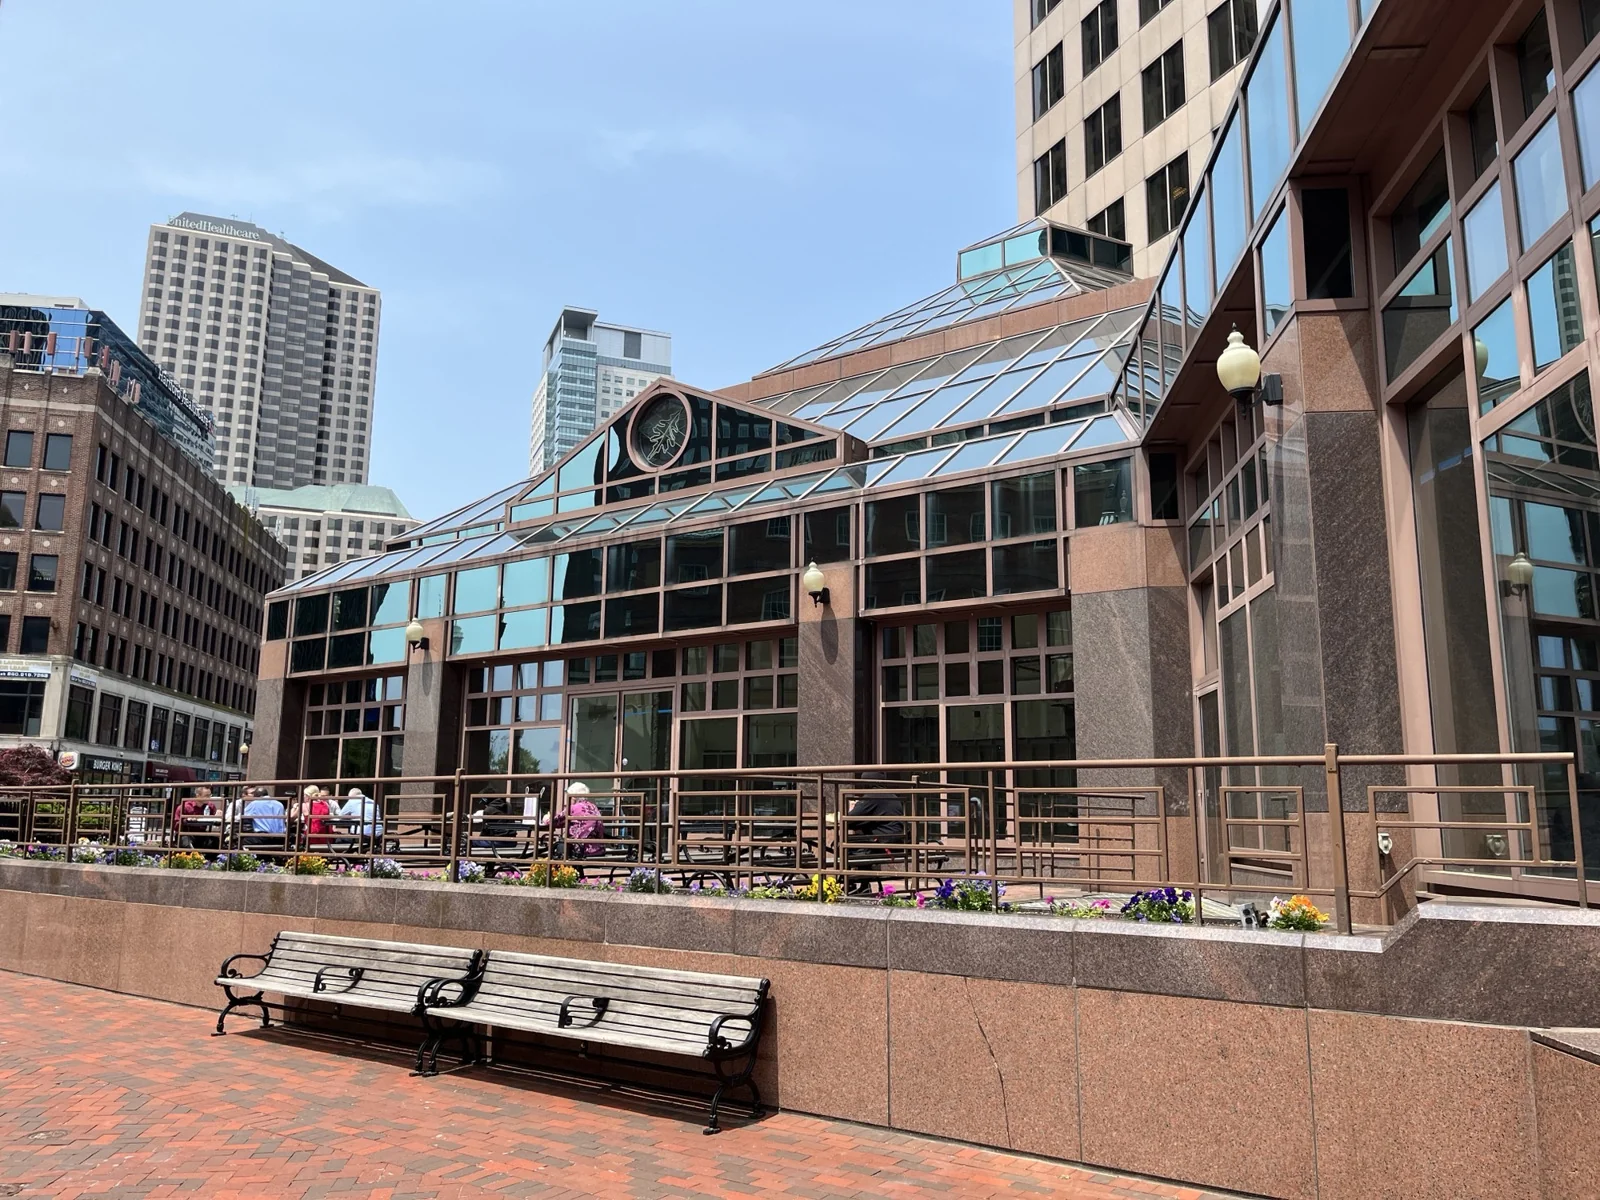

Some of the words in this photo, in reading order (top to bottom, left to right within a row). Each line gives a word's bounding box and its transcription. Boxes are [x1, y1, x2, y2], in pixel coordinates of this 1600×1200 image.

[168, 216, 260, 240] UnitedHealthcare
[93, 759, 110, 770] BURGER
[111, 761, 123, 772] KING
